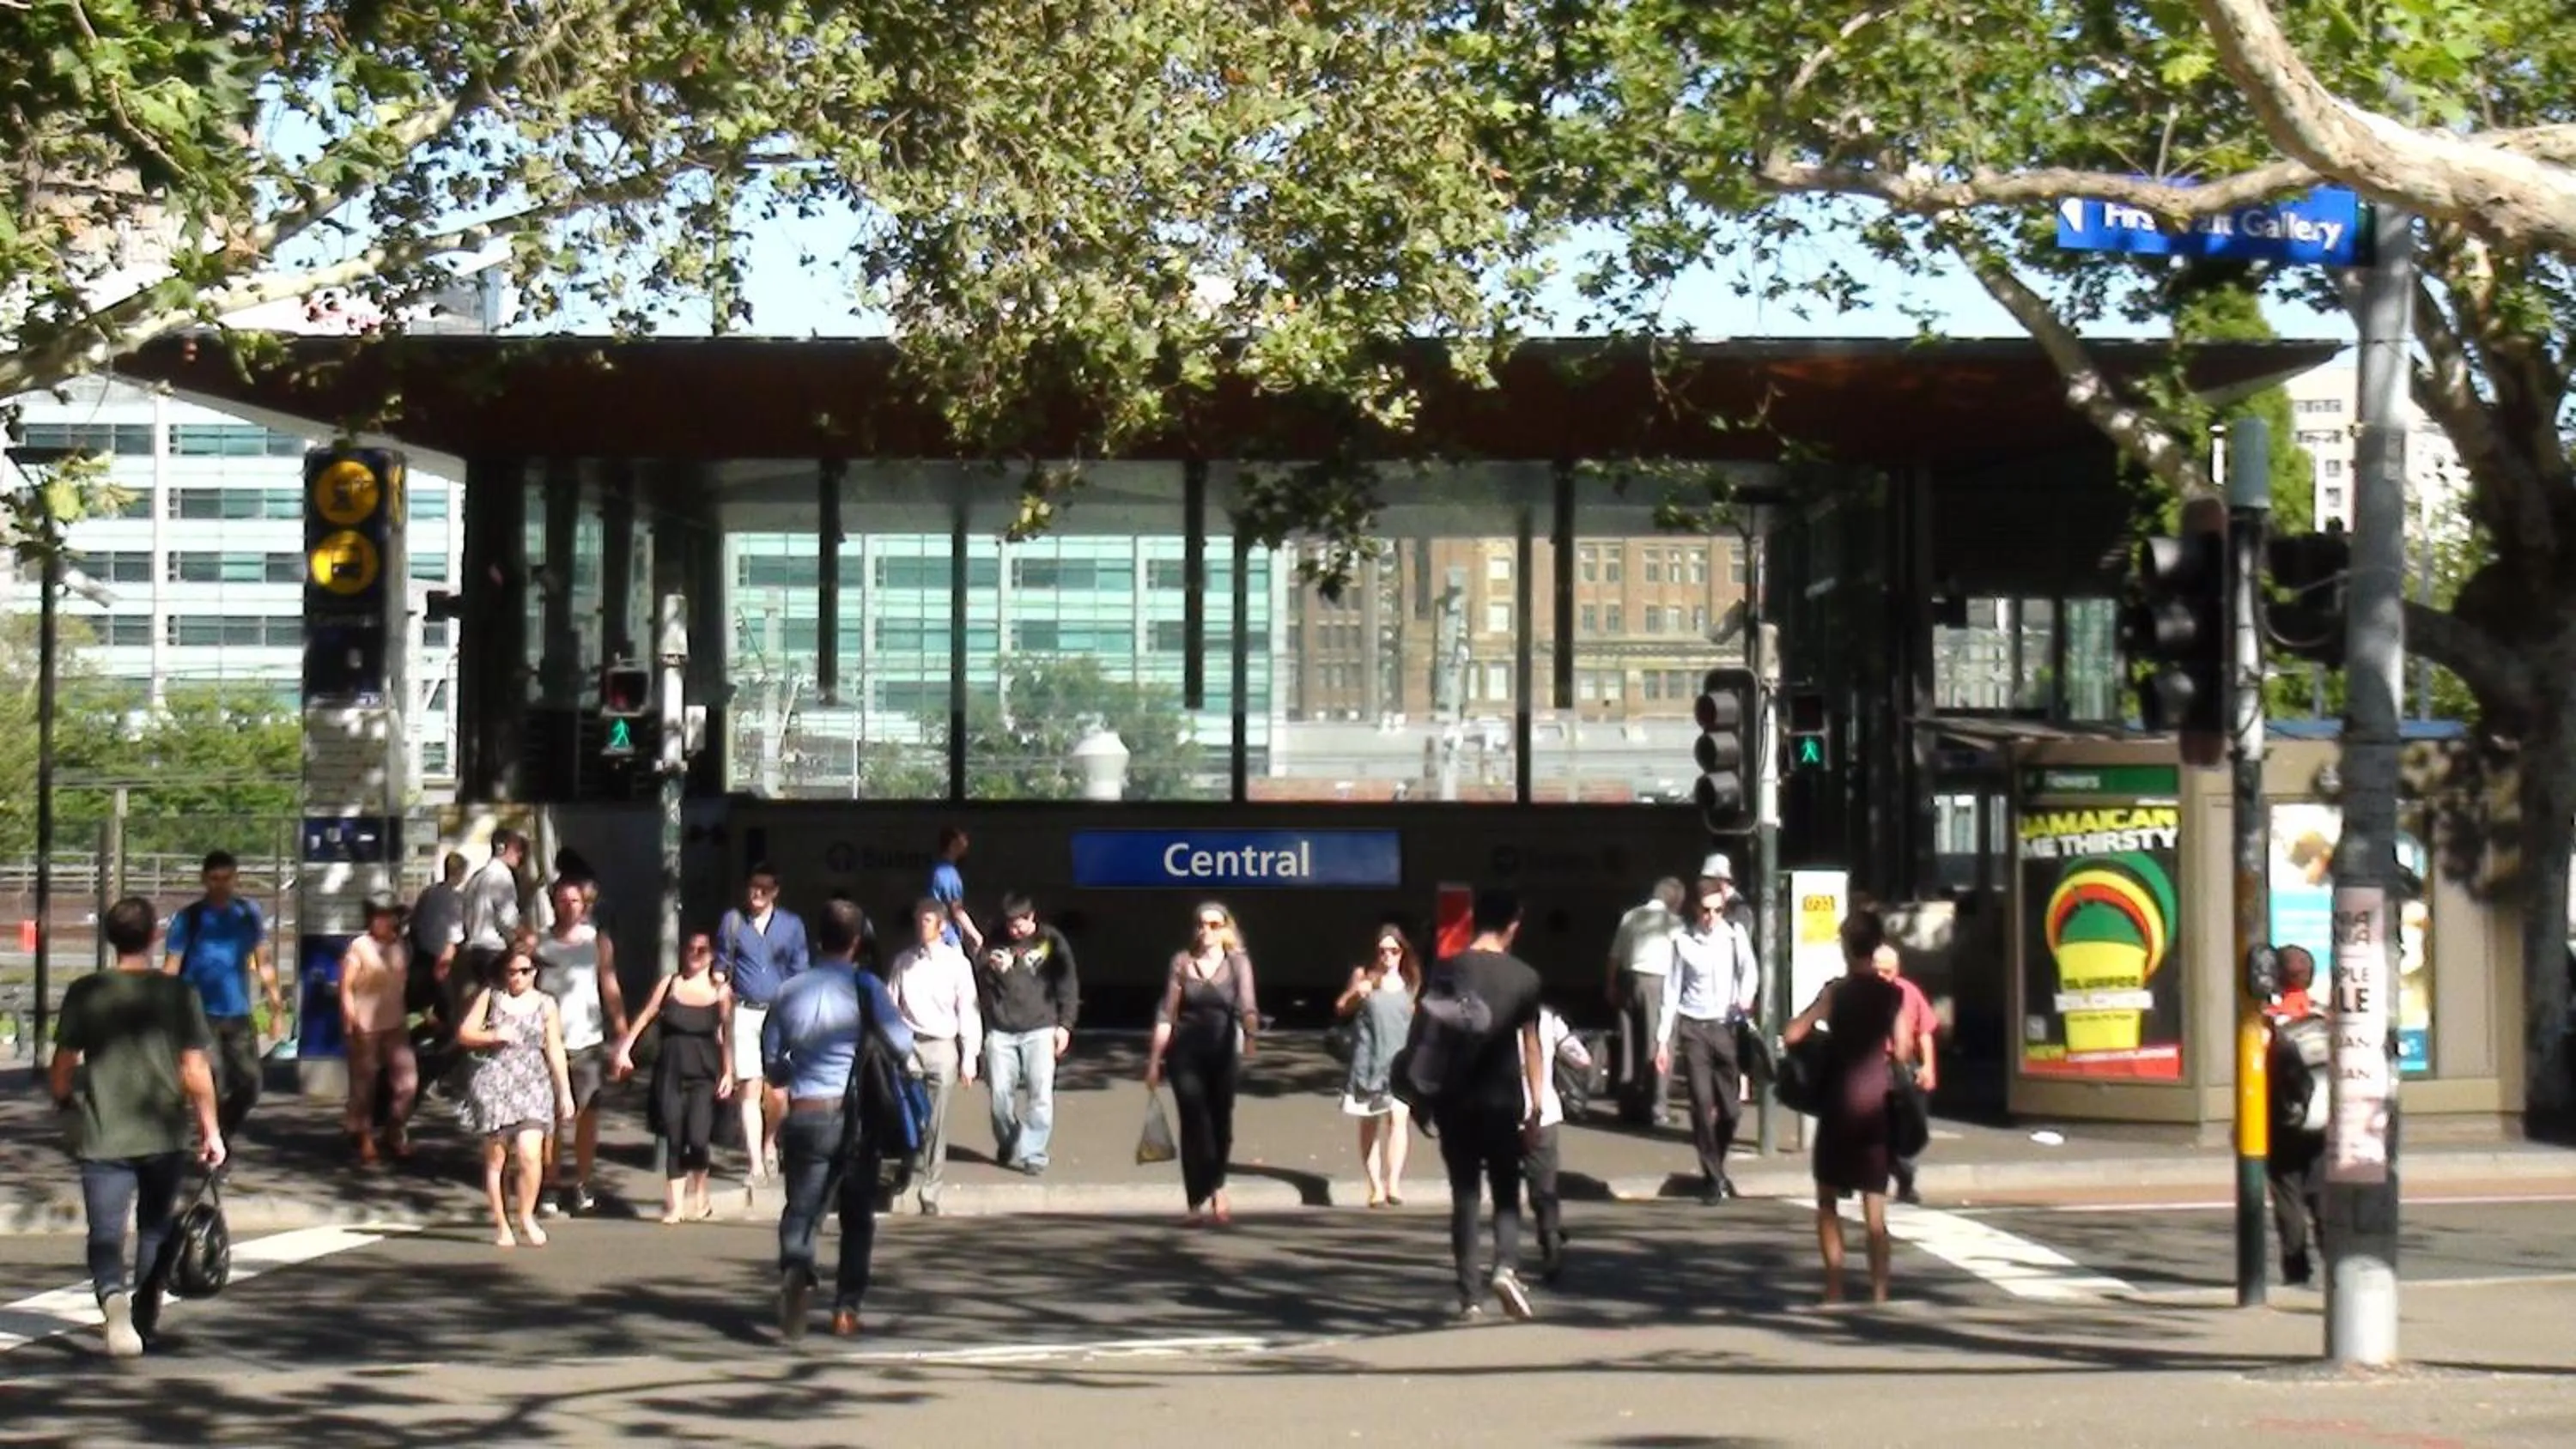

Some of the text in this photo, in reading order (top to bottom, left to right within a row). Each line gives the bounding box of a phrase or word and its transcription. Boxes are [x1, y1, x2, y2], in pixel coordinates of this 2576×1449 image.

[2242, 209, 2343, 251] Gallery
[2020, 808, 2178, 840] JAMAICAN
[1163, 840, 1310, 877] Central
[2058, 826, 2178, 857] THIRSTY
